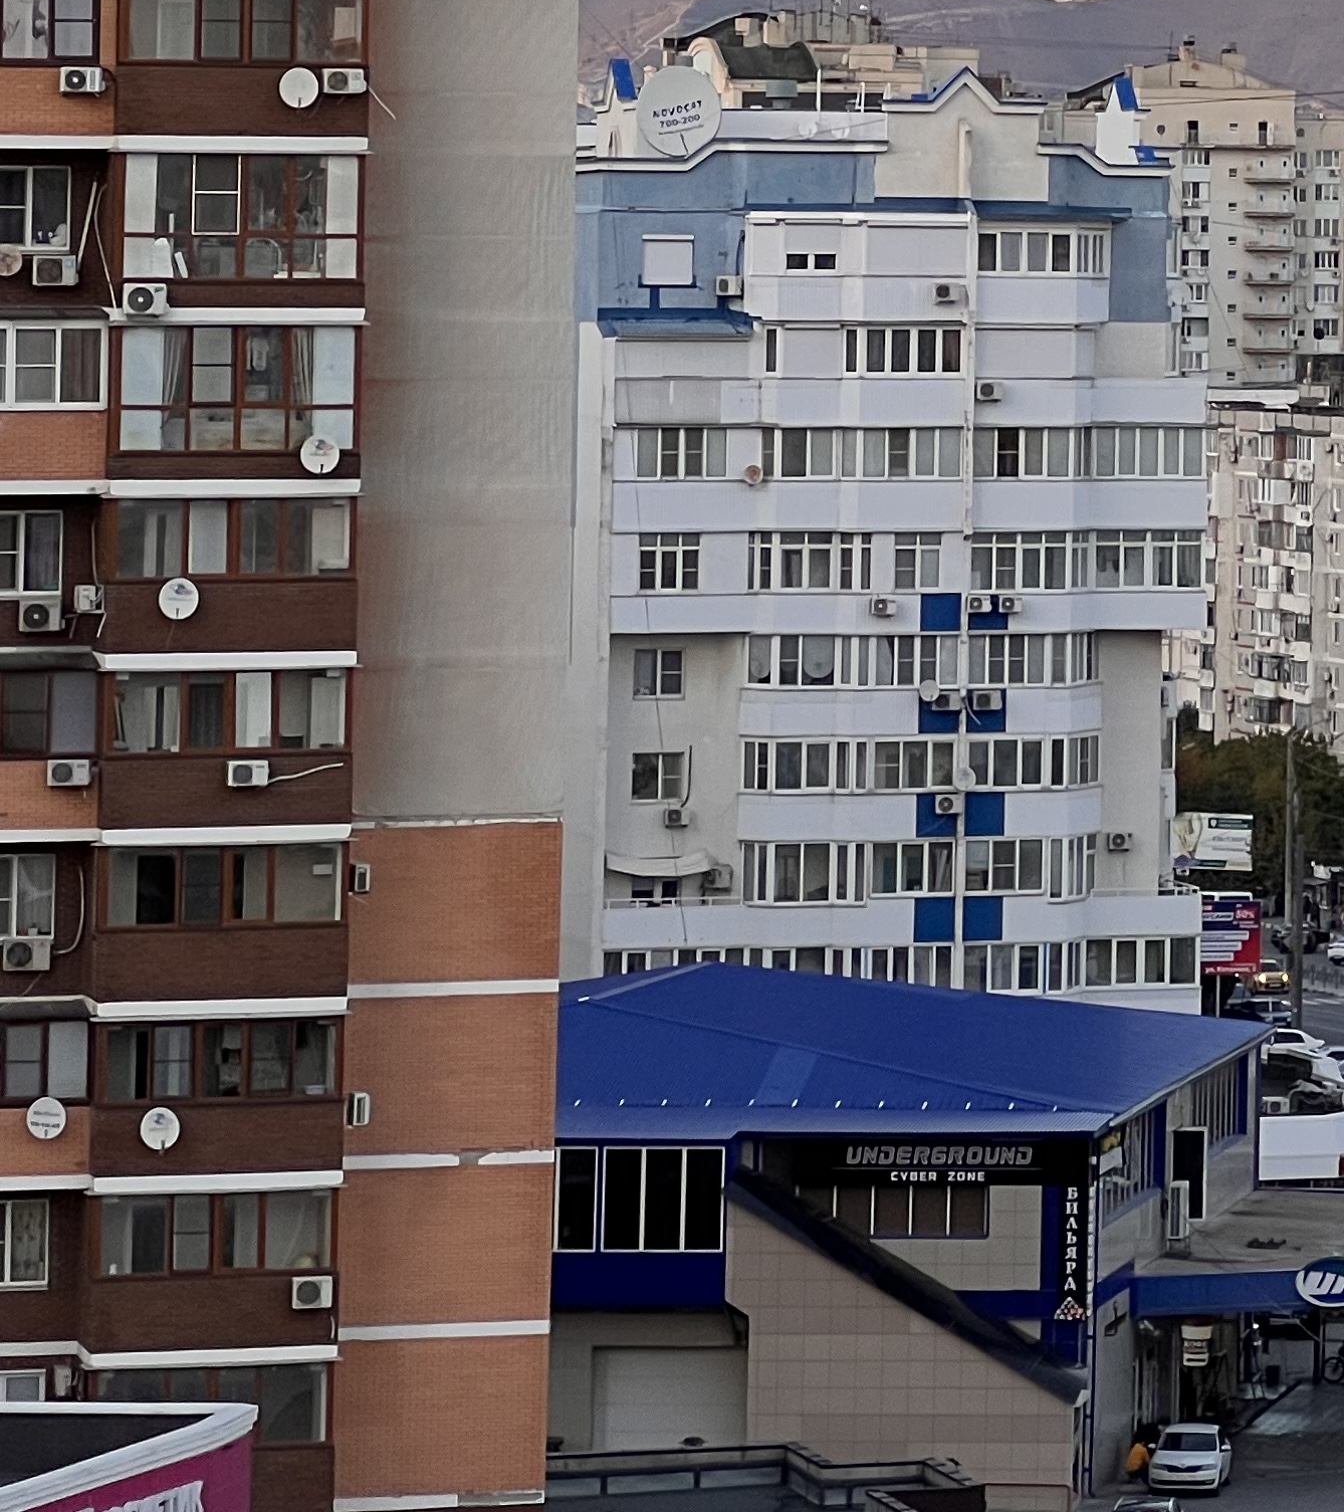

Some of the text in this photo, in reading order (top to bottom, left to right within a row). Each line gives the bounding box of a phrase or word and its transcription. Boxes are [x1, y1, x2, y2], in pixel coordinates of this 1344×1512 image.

[846, 1146, 1033, 1165] UNDERGROUND
[891, 1171, 986, 1181] CYBER ZONE
